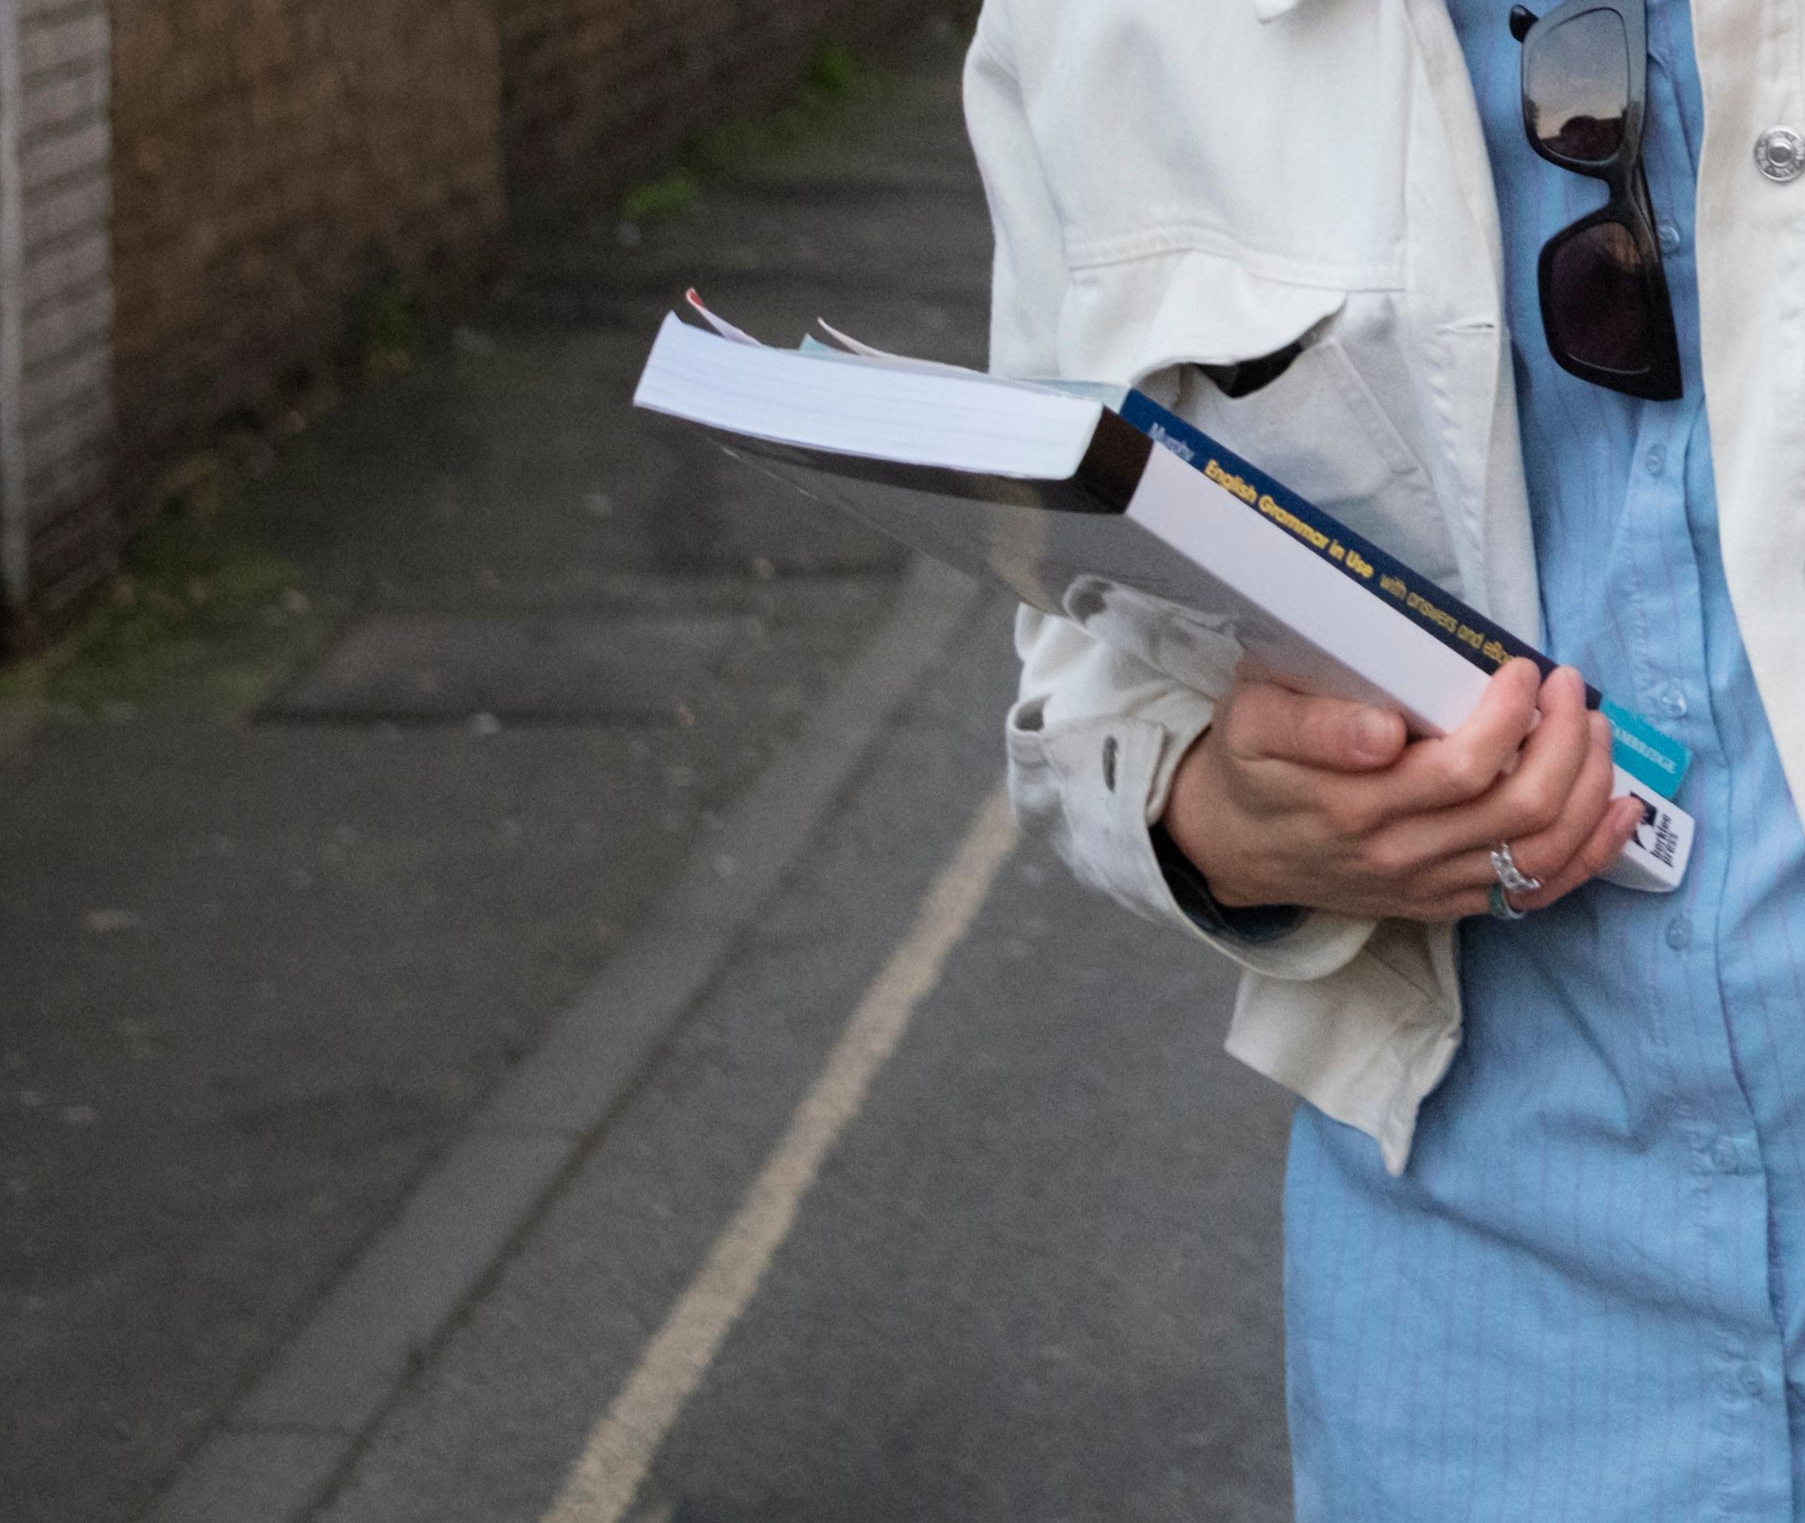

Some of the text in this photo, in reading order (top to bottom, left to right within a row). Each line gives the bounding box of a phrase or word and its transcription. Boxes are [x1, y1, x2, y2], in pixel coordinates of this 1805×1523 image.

[1204, 459, 1257, 504] English
[1258, 494, 1329, 550] Grammar
[1329, 539, 1344, 560] in
[1345, 549, 1374, 578] Use
[1380, 575, 1407, 601] with
[1407, 592, 1458, 633] answers
[1457, 624, 1485, 649] and
[1650, 814, 1671, 861] berklee
[1661, 834, 1679, 868] press
